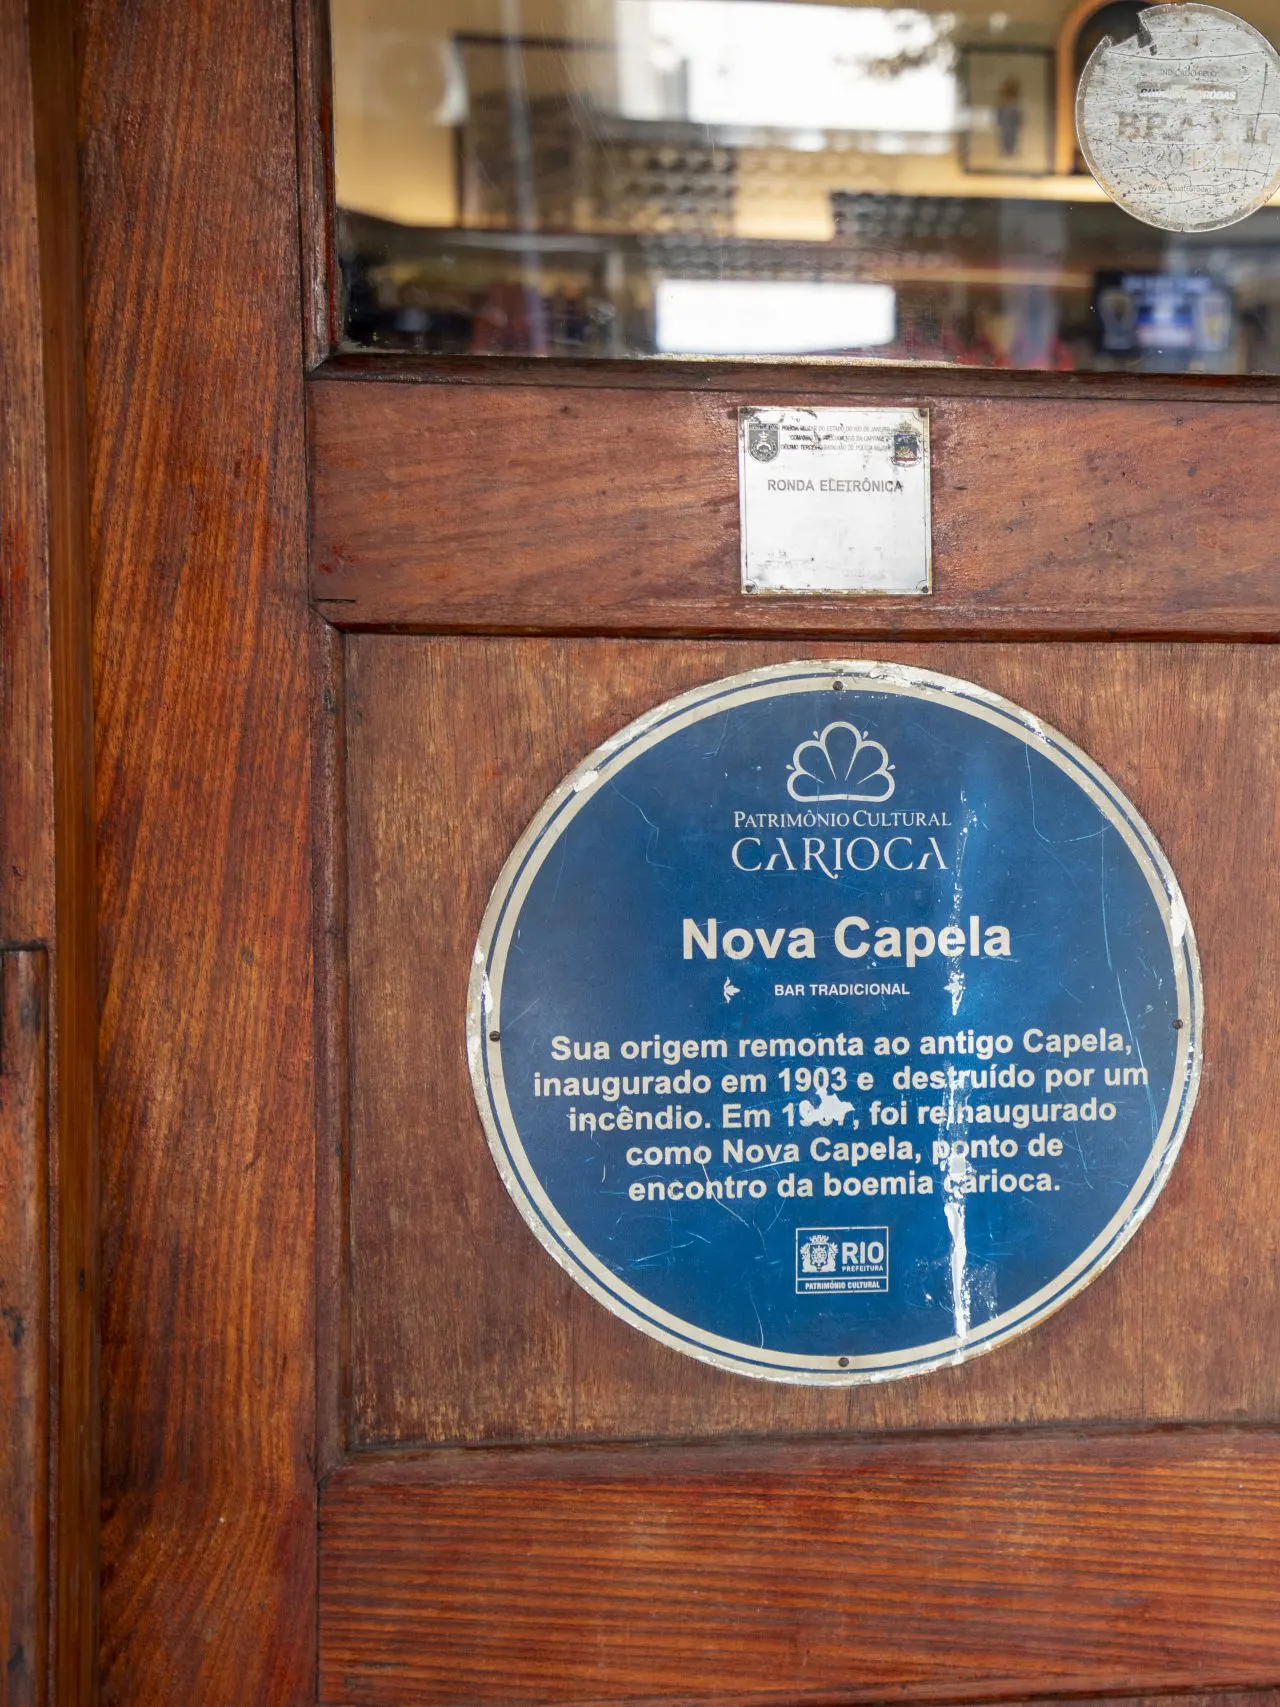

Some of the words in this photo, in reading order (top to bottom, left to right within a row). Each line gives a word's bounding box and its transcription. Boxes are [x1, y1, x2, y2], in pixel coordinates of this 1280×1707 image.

[767, 479, 815, 492] RONDA
[819, 477, 904, 492] ELETRÔNICA
[852, 809, 952, 827] CULTURAL
[731, 836, 949, 880] CARIOCA
[683, 918, 816, 960] Nova
[834, 915, 1011, 968] Capela
[774, 984, 805, 996] BAR
[809, 983, 910, 996] TRADICIONAL
[551, 1035, 610, 1061] Sua
[620, 1034, 728, 1065] origem
[739, 1033, 864, 1058] remonta
[873, 1035, 910, 1056] ao
[920, 1029, 1014, 1060] antigo
[1022, 1028, 1132, 1059] Capela,
[534, 1069, 712, 1102] inaugurado
[721, 1072, 767, 1093] em
[778, 1066, 847, 1092] 1903
[857, 1071, 874, 1091] e
[892, 1064, 1035, 1090] destruído
[1045, 1067, 1095, 1093] por
[1104, 1067, 1149, 1086] um
[569, 1105, 711, 1132] incêndio.
[722, 1103, 770, 1128] Em
[869, 1100, 908, 1126] foi
[917, 1097, 1117, 1129] reinaugurado
[626, 1145, 712, 1166] como
[722, 1138, 800, 1164] Nova
[810, 1136, 922, 1167] Capela,
[932, 1134, 1018, 1165] ponto
[1027, 1132, 1064, 1157] de
[628, 1175, 767, 1201] encontro
[777, 1173, 814, 1198] da
[824, 1170, 934, 1197] boemia
[943, 1168, 1061, 1193] carioca.
[842, 1241, 884, 1264] RIO
[847, 1281, 880, 1289] CULTURAL
